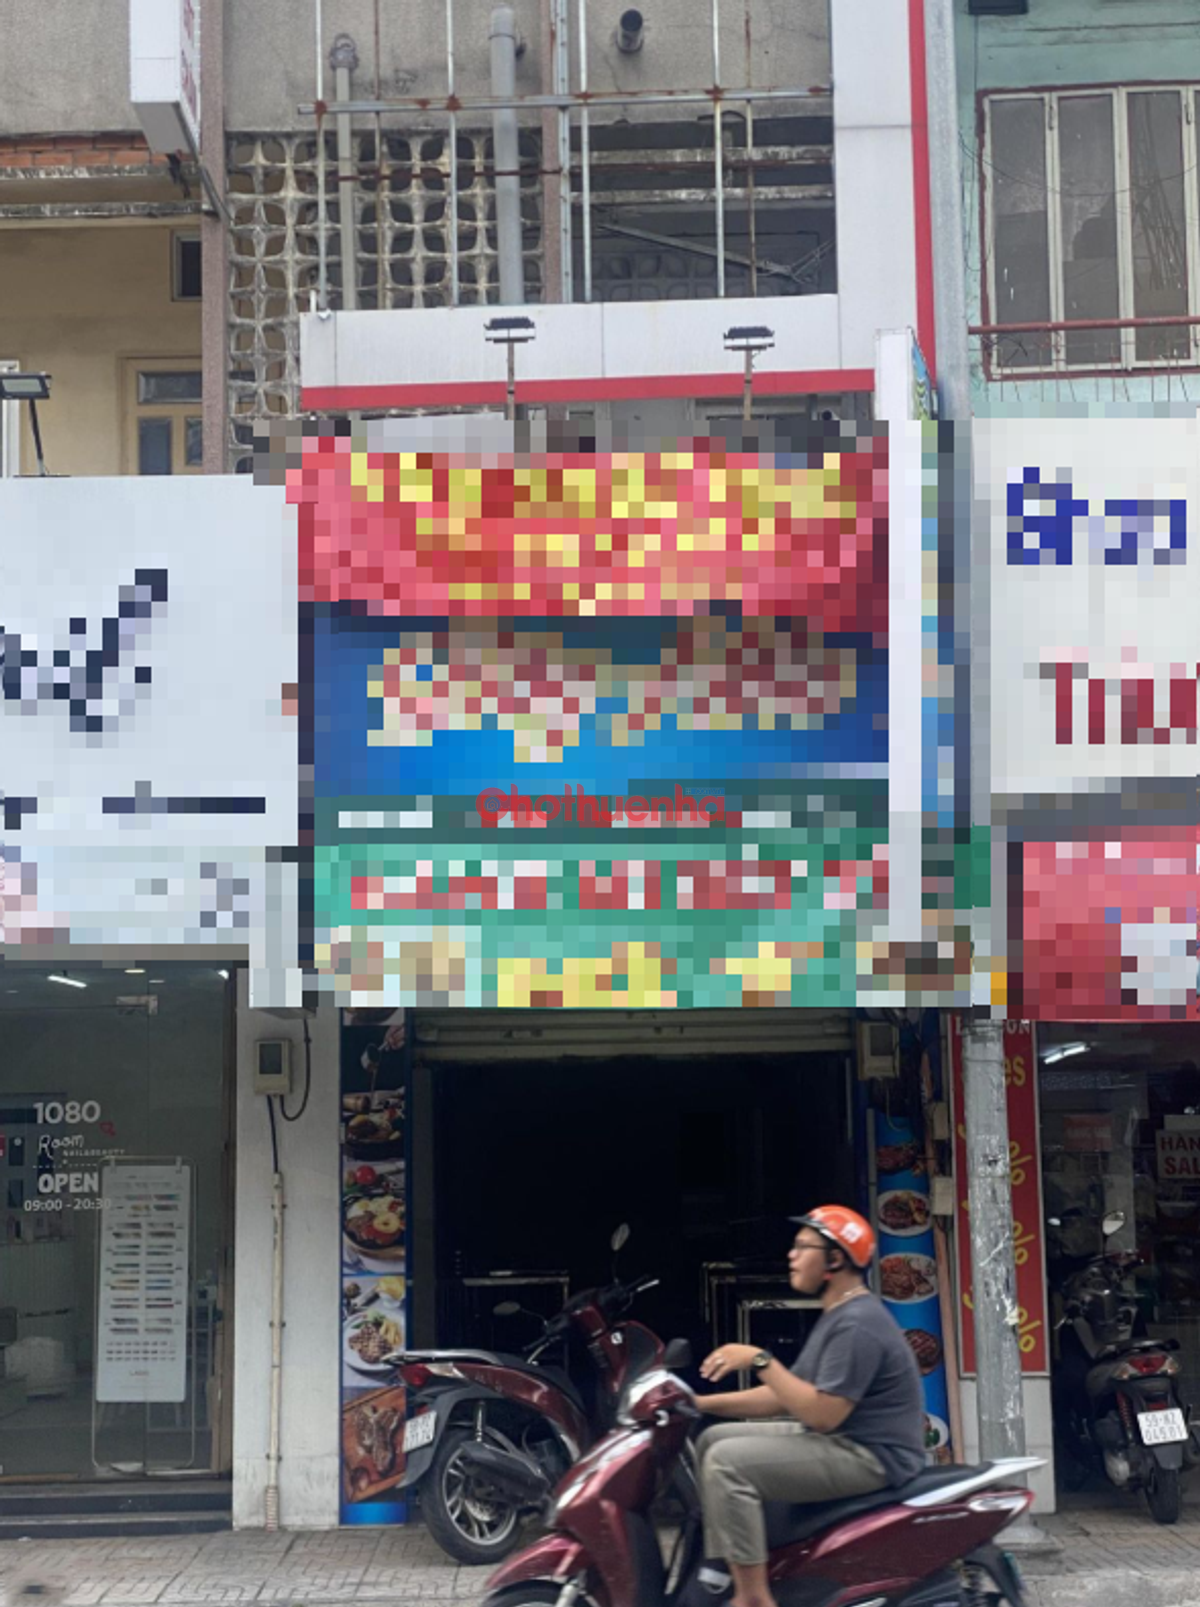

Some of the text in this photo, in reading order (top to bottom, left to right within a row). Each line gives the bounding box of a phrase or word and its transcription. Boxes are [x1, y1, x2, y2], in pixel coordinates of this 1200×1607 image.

[33, 1100, 101, 1124] 1080
[39, 1134, 85, 1159] Room
[38, 1172, 99, 1193] OPEN
[24, 1199, 63, 1212] 09:00
